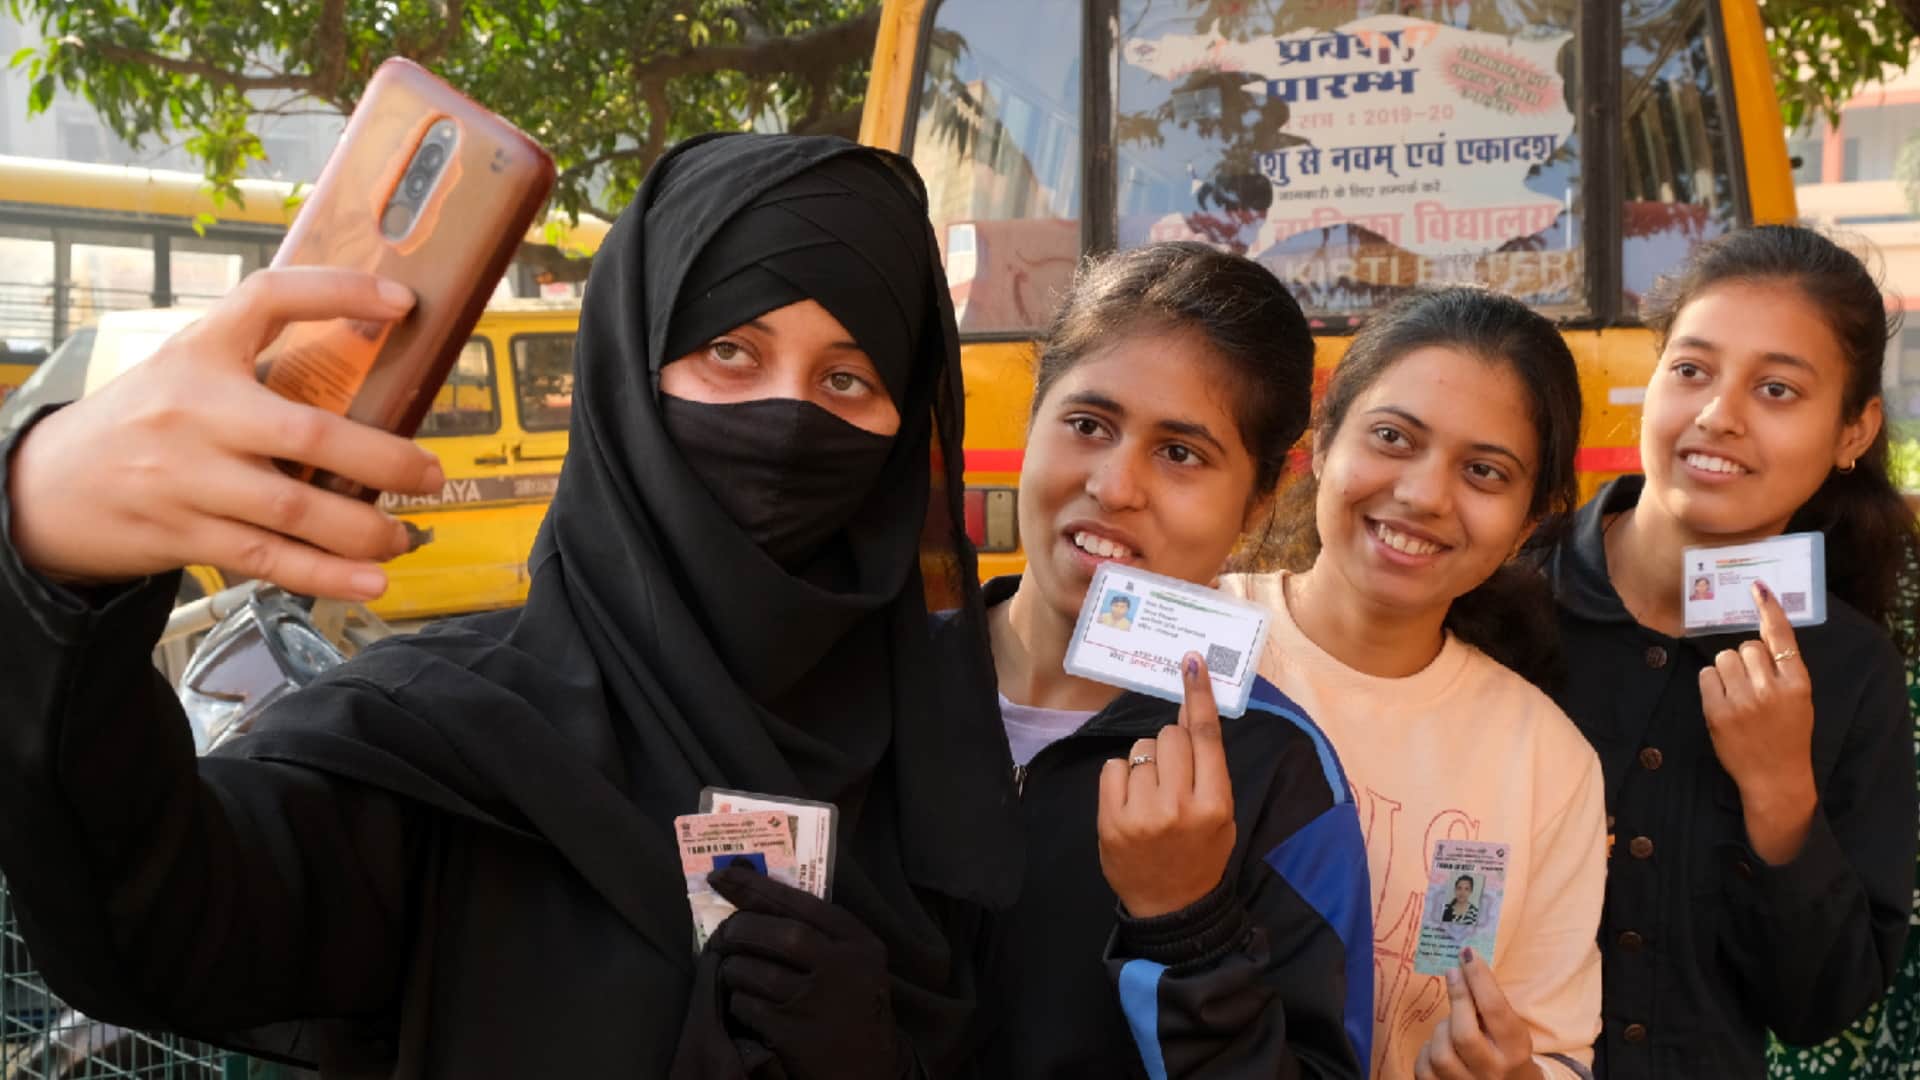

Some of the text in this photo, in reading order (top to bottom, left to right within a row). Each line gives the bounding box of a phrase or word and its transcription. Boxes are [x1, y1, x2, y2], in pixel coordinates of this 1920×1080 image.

[1297, 147, 1321, 175] से
[1331, 144, 1399, 177] नवम्
[1405, 132, 1447, 167] एवं
[1457, 134, 1558, 164] एकादश
